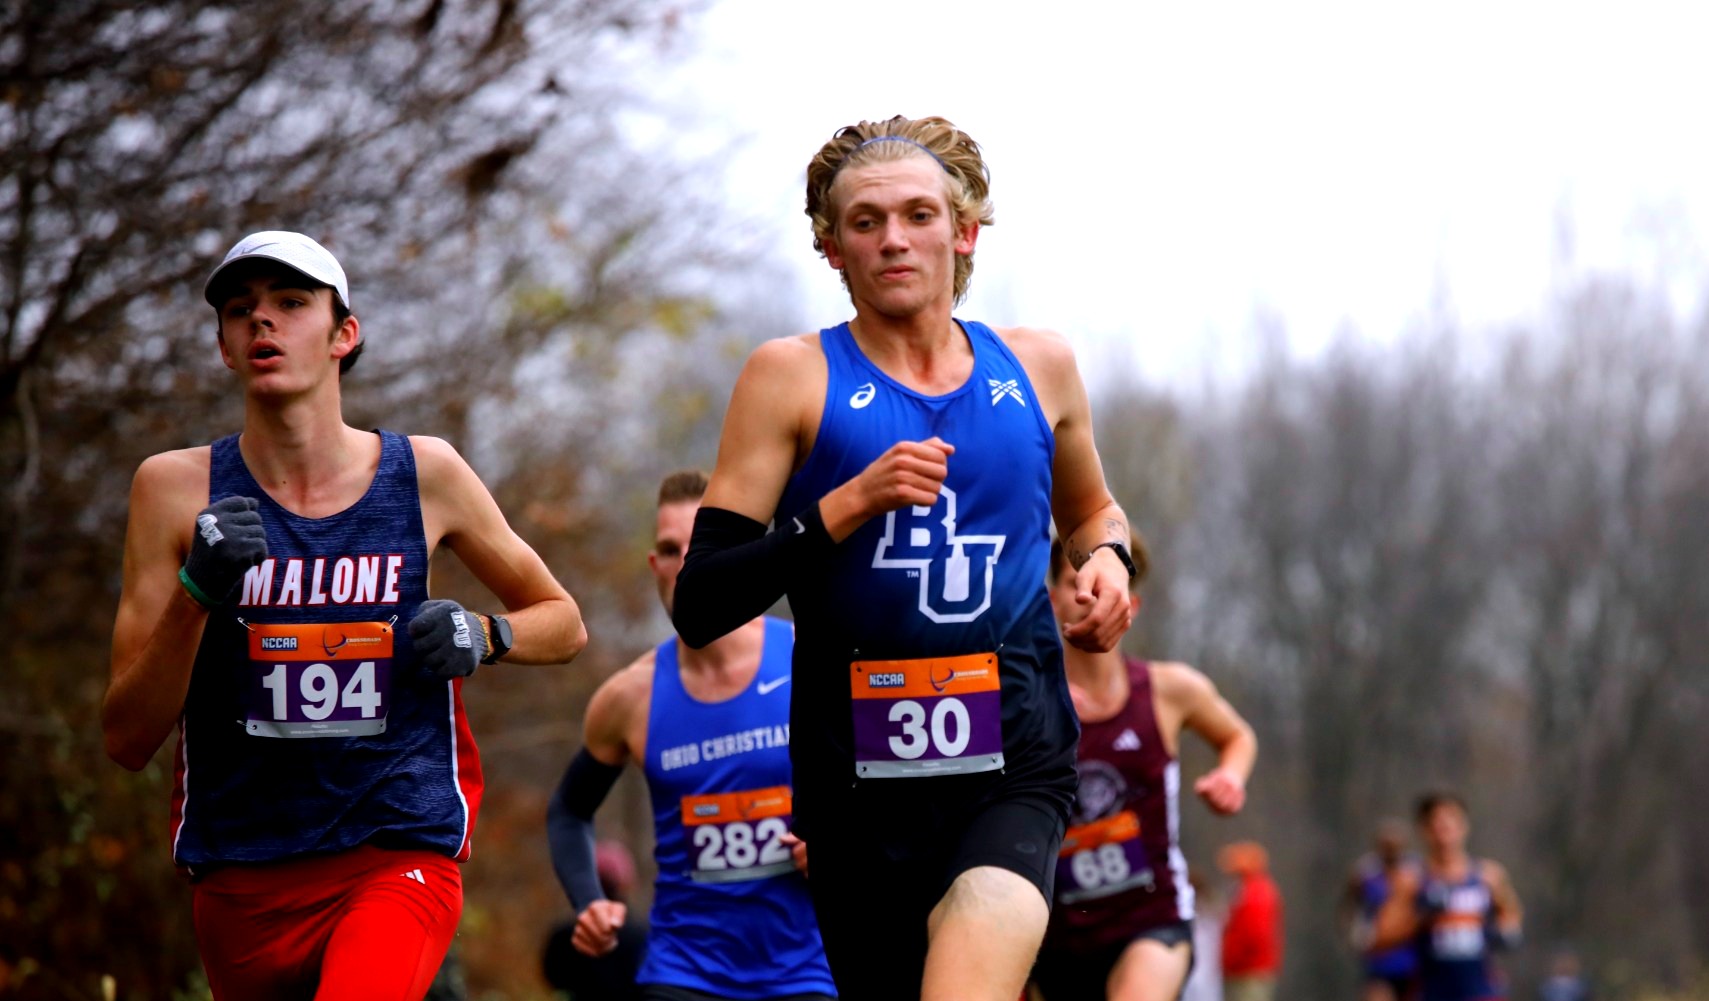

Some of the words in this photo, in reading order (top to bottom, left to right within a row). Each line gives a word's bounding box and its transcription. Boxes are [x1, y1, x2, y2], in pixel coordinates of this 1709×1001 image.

[872, 483, 1006, 624] BU
[239, 555, 403, 606] MALONE
[261, 636, 298, 651] NCCAA
[262, 661, 381, 721] 194
[869, 673, 905, 688] NCCAA
[888, 697, 971, 760] 30
[661, 744, 699, 771] OHIO
[694, 817, 790, 870] 282
[1071, 843, 1131, 889] 68
